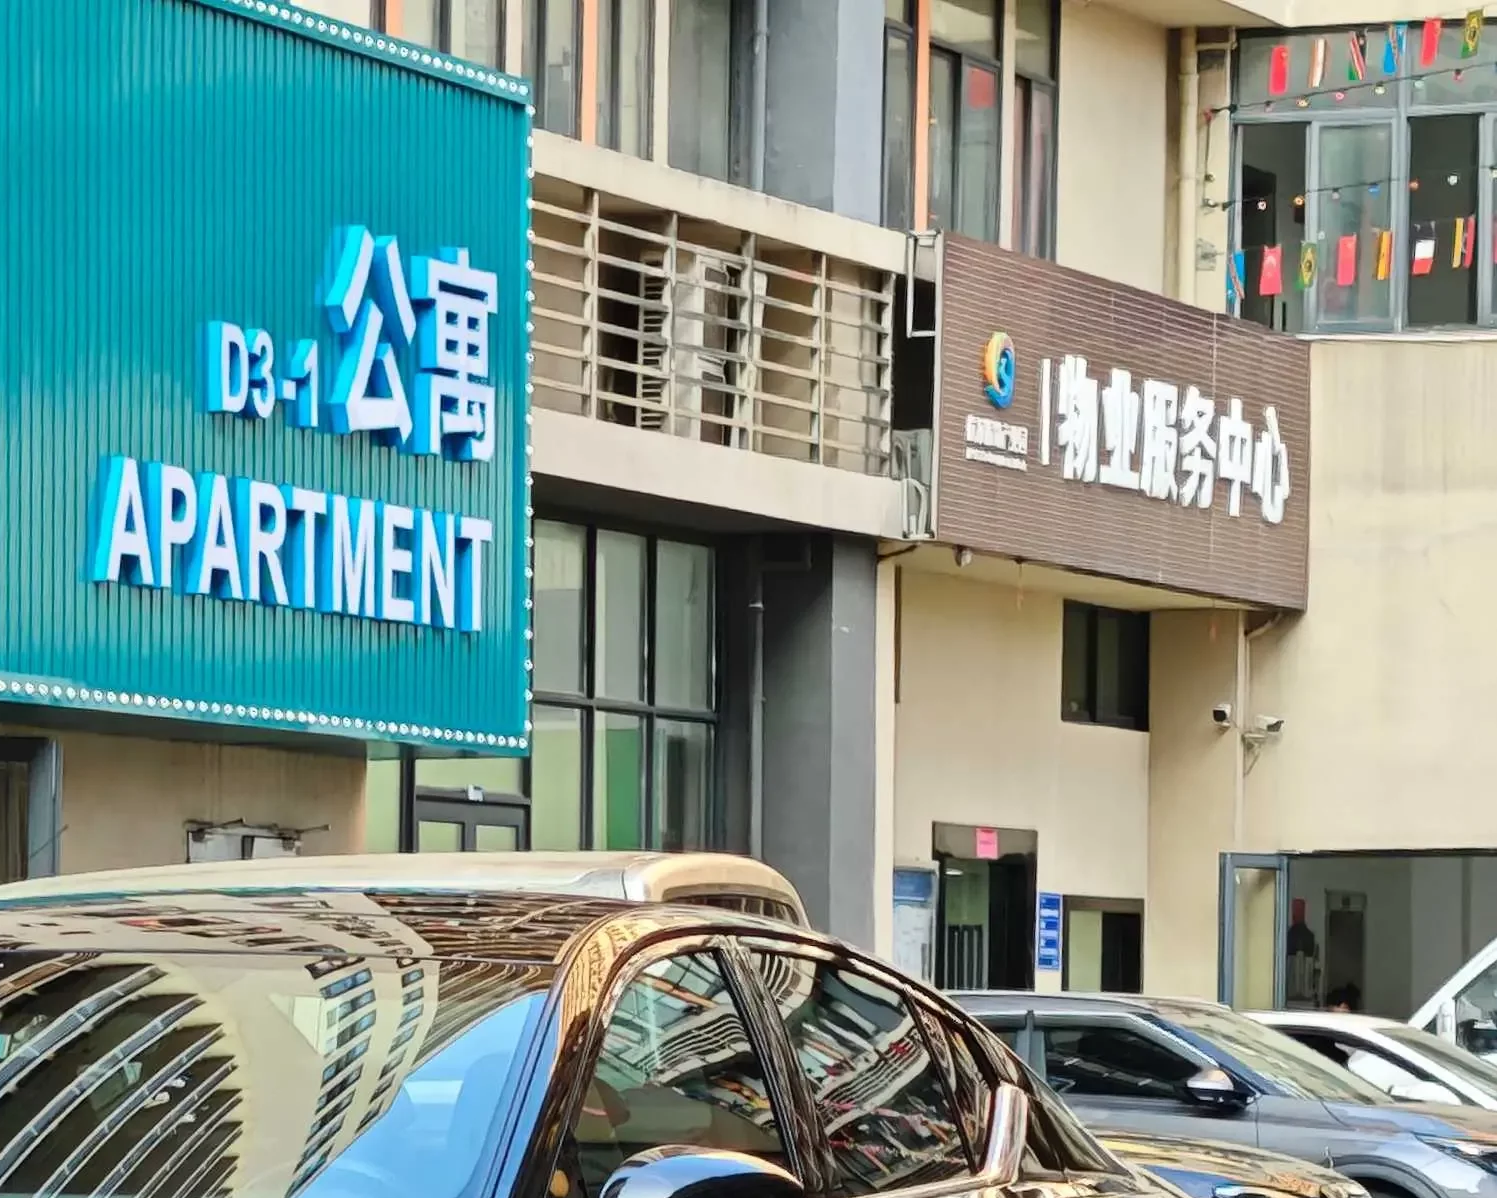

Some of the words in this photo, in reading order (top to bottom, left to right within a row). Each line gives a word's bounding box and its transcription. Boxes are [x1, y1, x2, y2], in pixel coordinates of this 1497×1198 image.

[207, 320, 318, 428] D3-1
[324, 224, 499, 462] 公寓
[1058, 353, 1291, 525] 物业服务中心
[94, 455, 493, 633] APARTMENT
